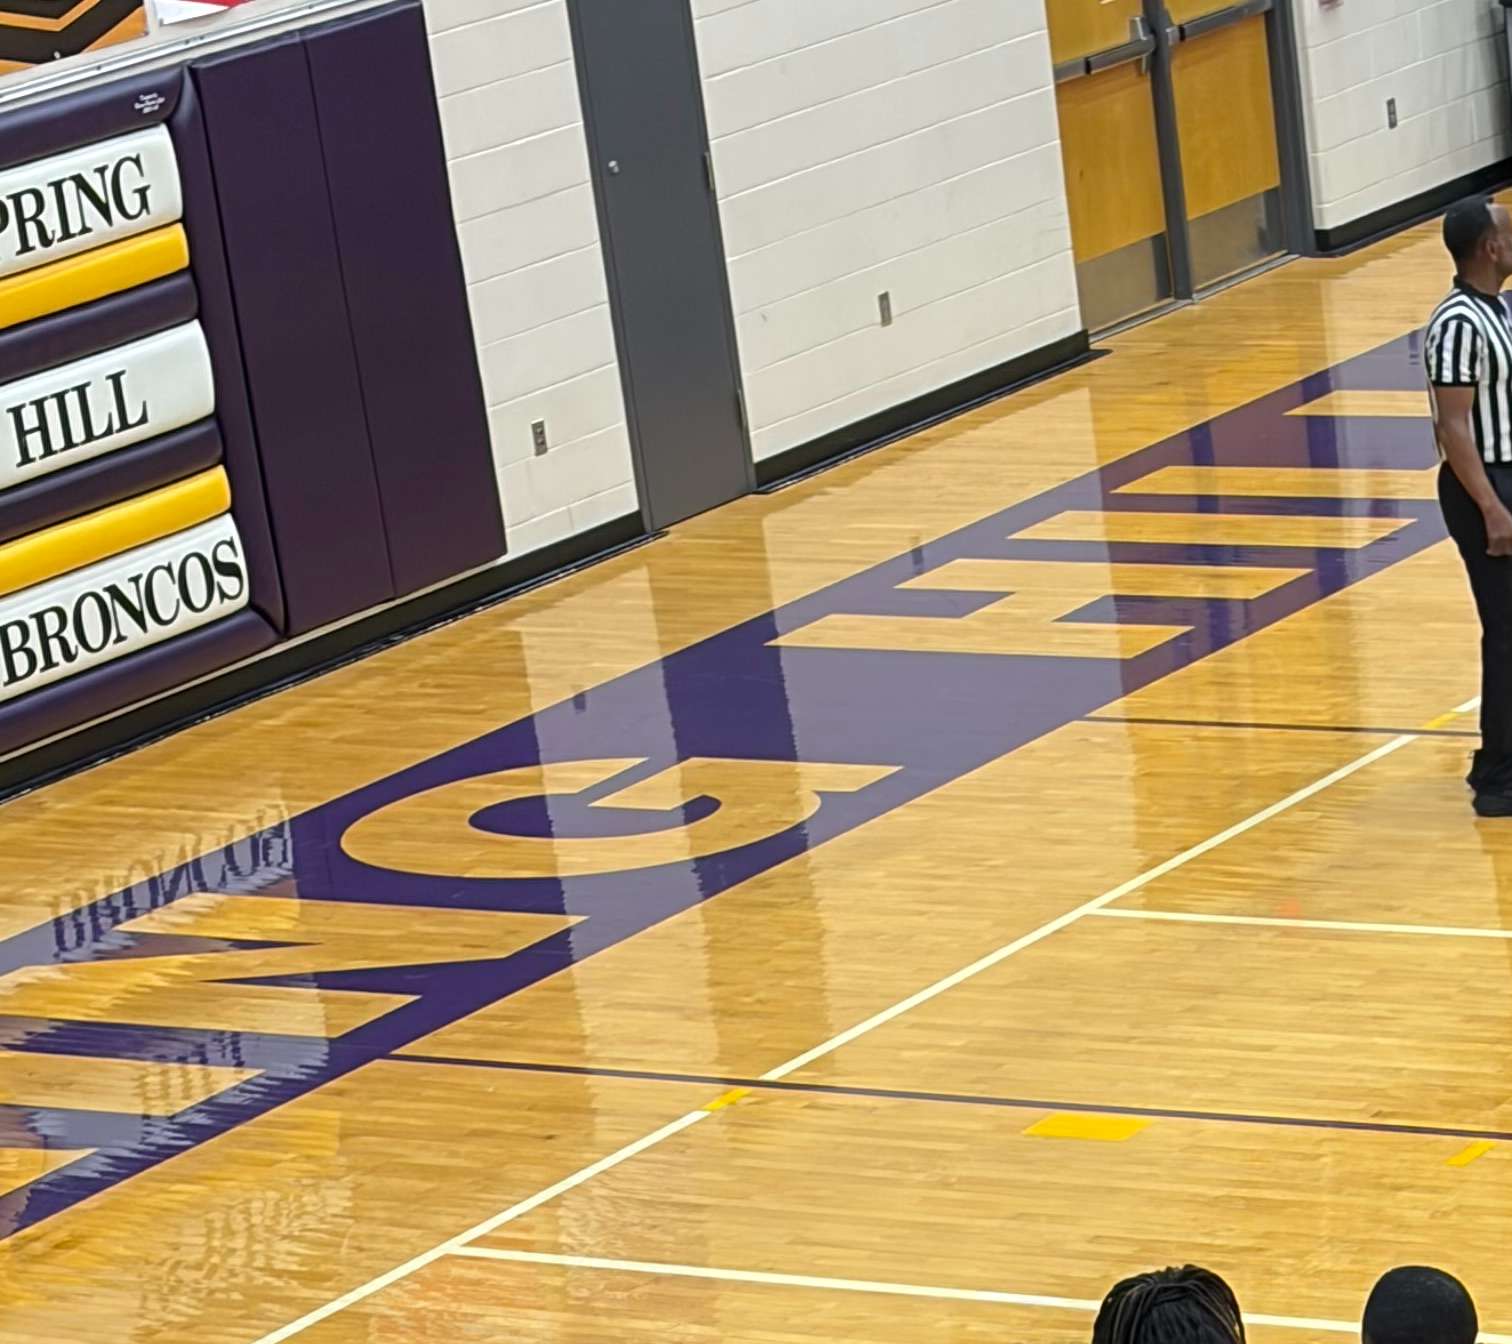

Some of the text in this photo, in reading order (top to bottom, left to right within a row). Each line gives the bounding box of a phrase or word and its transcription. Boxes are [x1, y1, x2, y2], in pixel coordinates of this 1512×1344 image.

[0, 153, 152, 256] RING
[6, 369, 149, 468] HILL
[0, 536, 244, 687] BRONCOS
